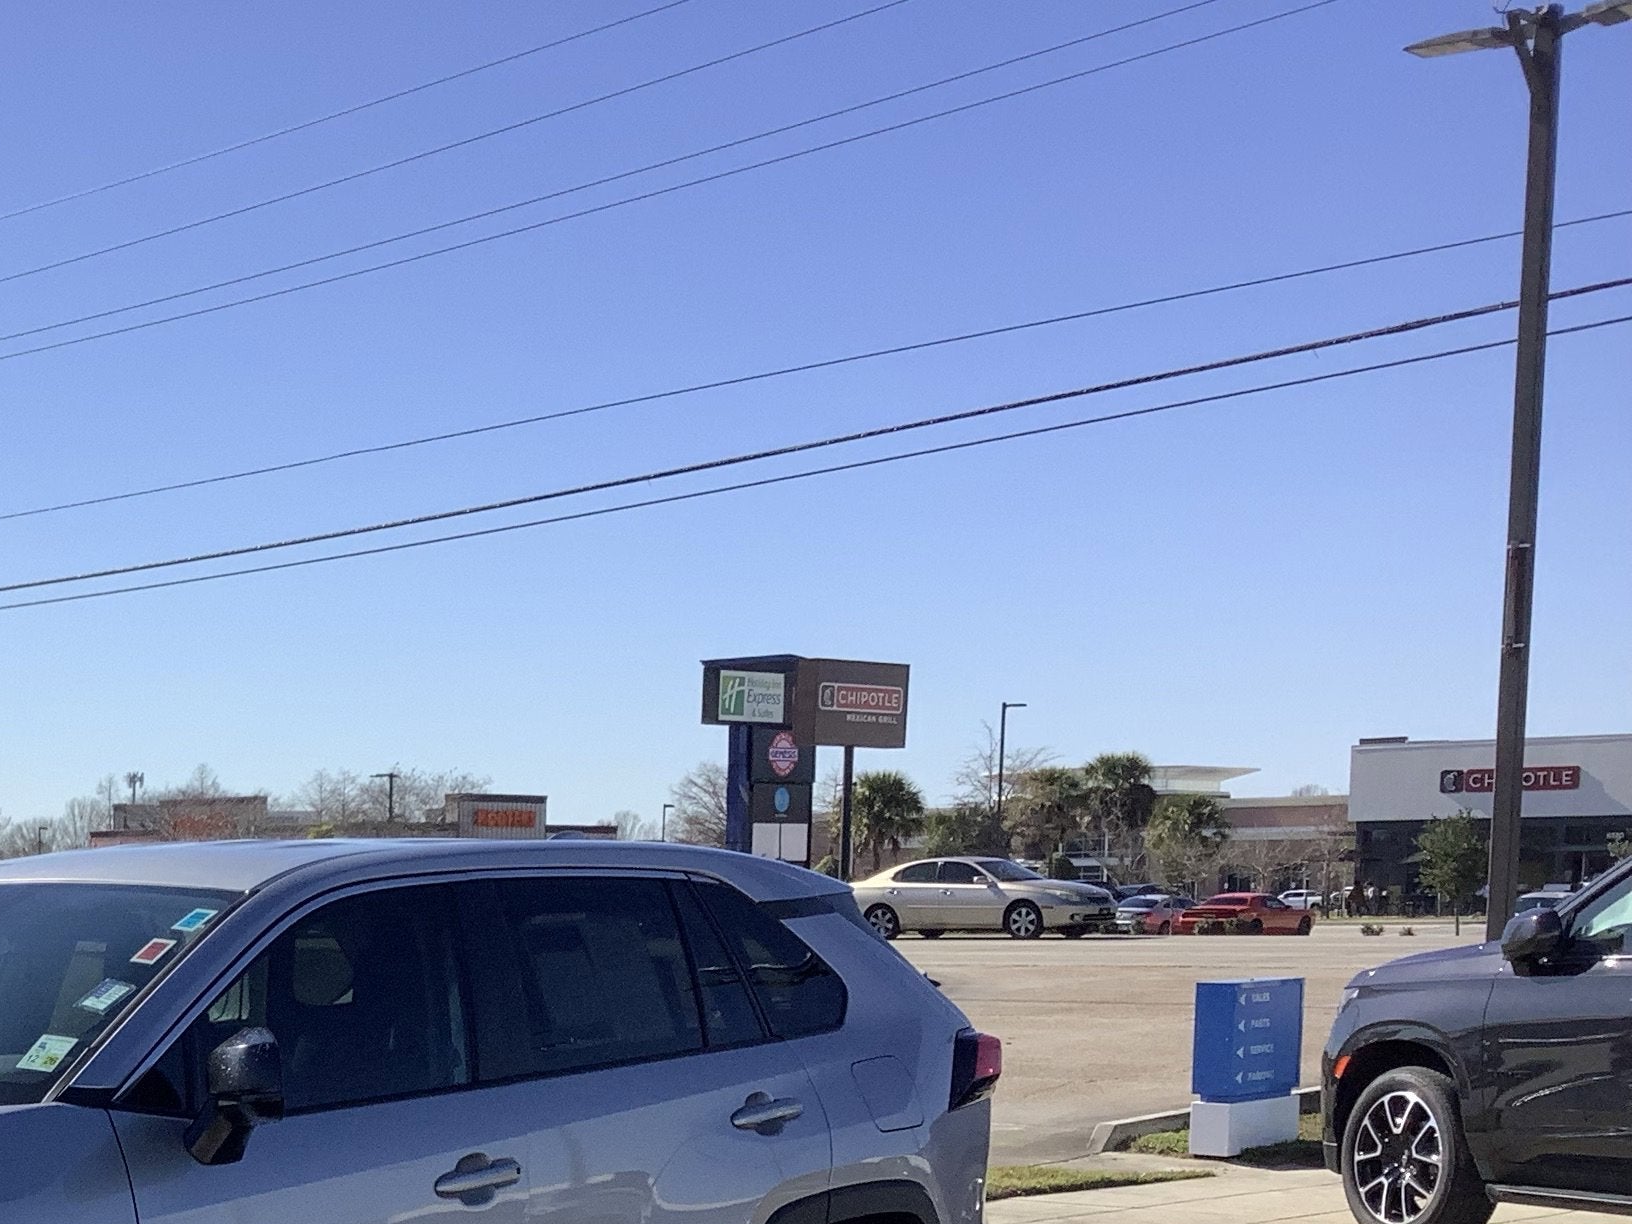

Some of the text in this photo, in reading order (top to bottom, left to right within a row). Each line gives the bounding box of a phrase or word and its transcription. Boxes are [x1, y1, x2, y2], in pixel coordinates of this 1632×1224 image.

[747, 688, 781, 706] Express
[838, 690, 900, 707] CHIPOTLE
[1469, 770, 1574, 788] CHOTLE
